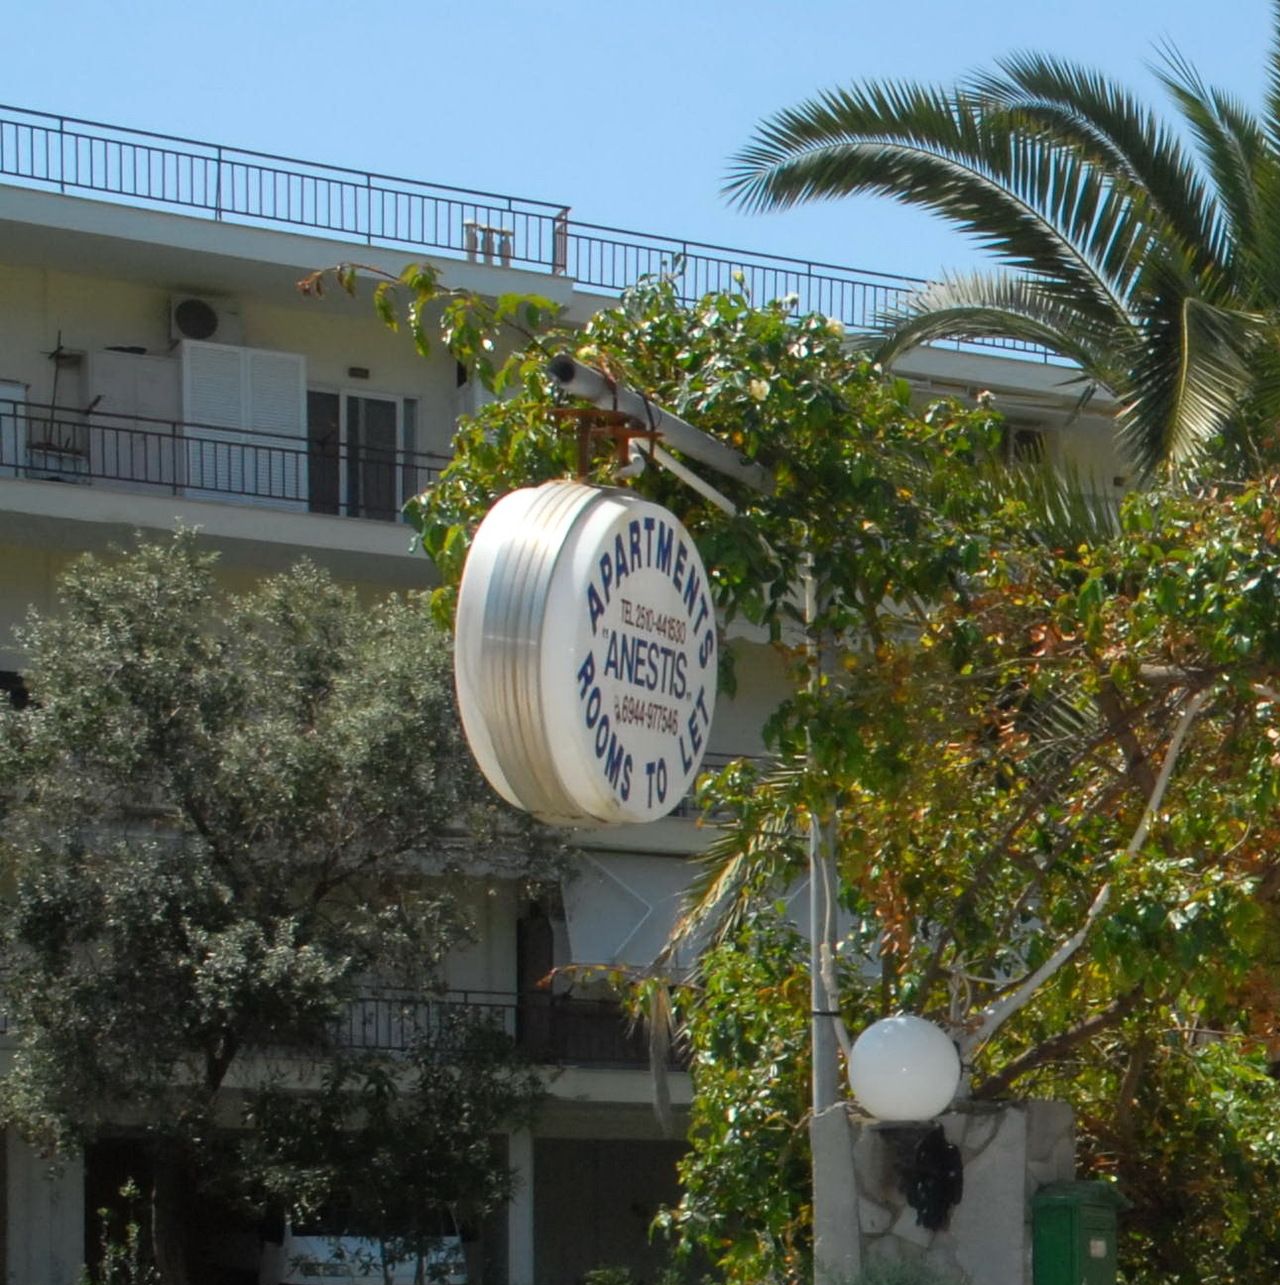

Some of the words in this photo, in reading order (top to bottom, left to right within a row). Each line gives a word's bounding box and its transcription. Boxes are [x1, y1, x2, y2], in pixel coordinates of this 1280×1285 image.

[587, 517, 713, 669] APARTMENTS
[578, 651, 632, 801] ROOMS
[645, 757, 668, 808] TO
[679, 686, 710, 775] LET
